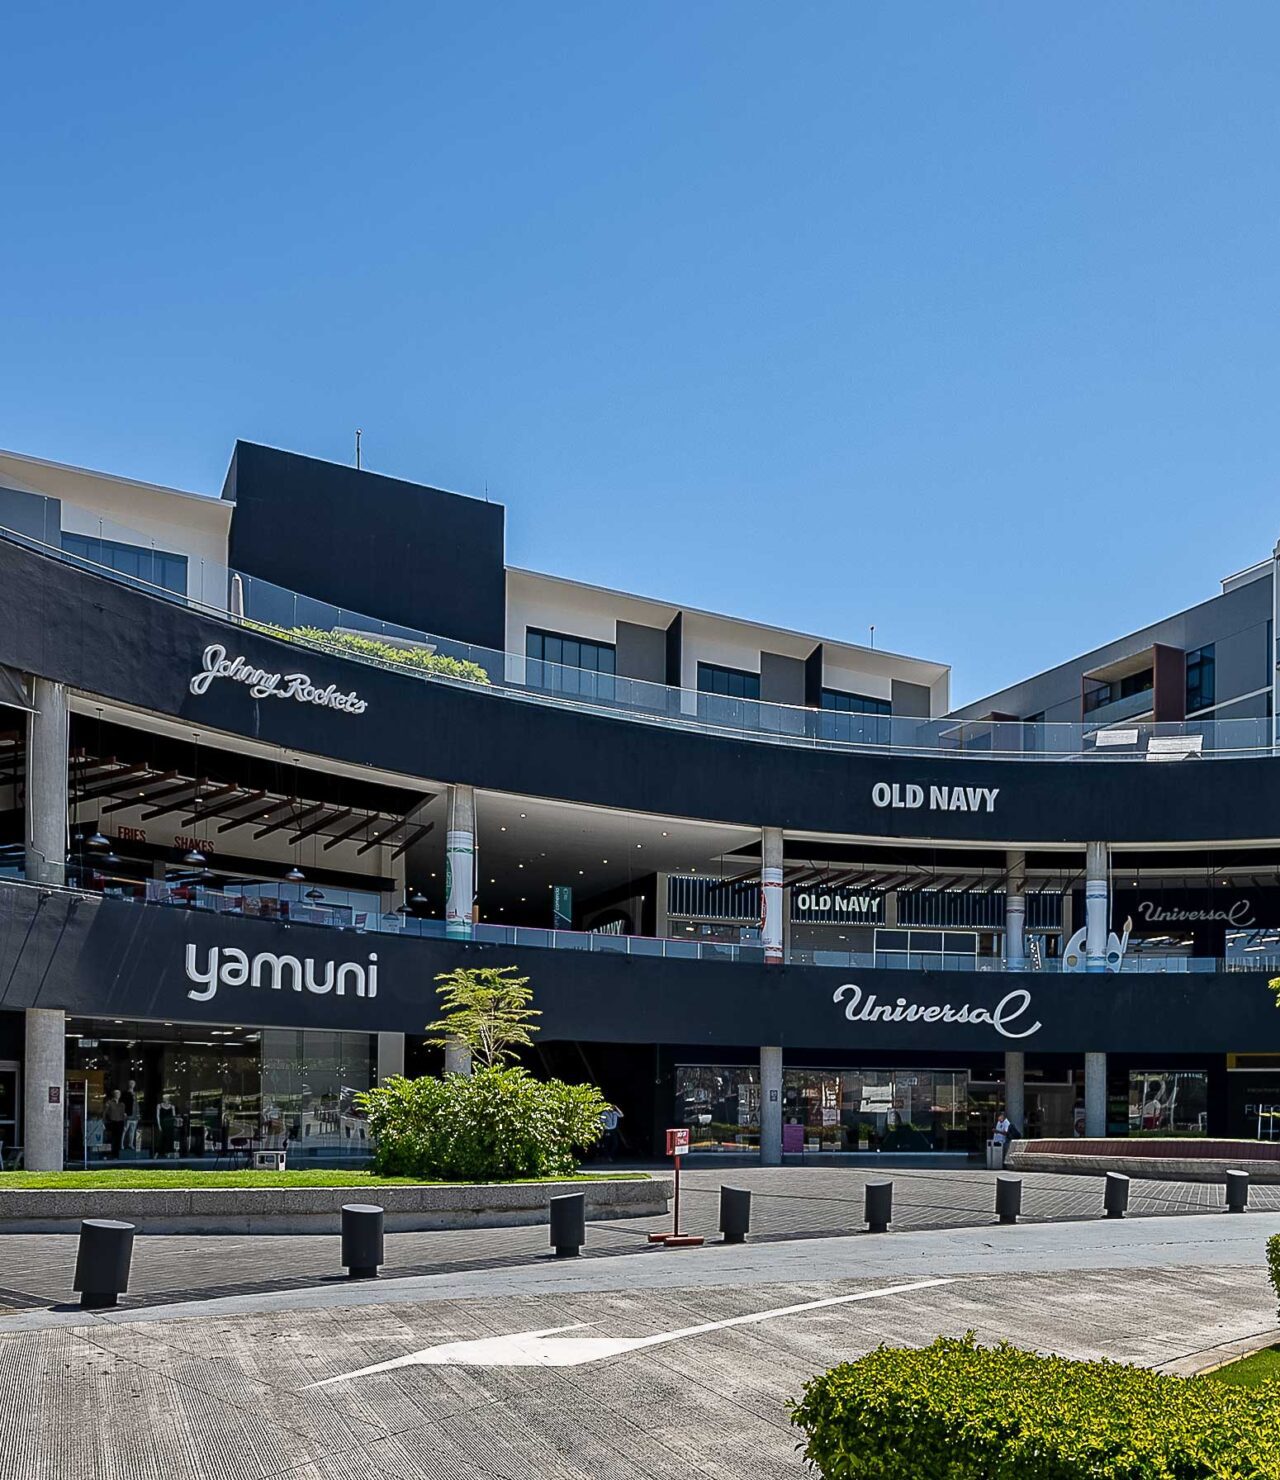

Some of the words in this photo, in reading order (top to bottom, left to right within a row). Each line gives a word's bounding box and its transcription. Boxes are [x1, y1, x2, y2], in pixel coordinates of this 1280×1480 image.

[190, 644, 280, 698] Johnny
[277, 673, 368, 714] Rockets
[871, 782, 925, 808] OLD
[929, 785, 1000, 812] NAVY
[118, 826, 146, 843] FRIES
[174, 836, 215, 854] SHAKES
[797, 893, 832, 910] OLD
[835, 895, 881, 913] NAVY
[1138, 900, 1256, 927] Universal
[186, 943, 378, 1002] yamuni
[833, 983, 1042, 1038] Universal
